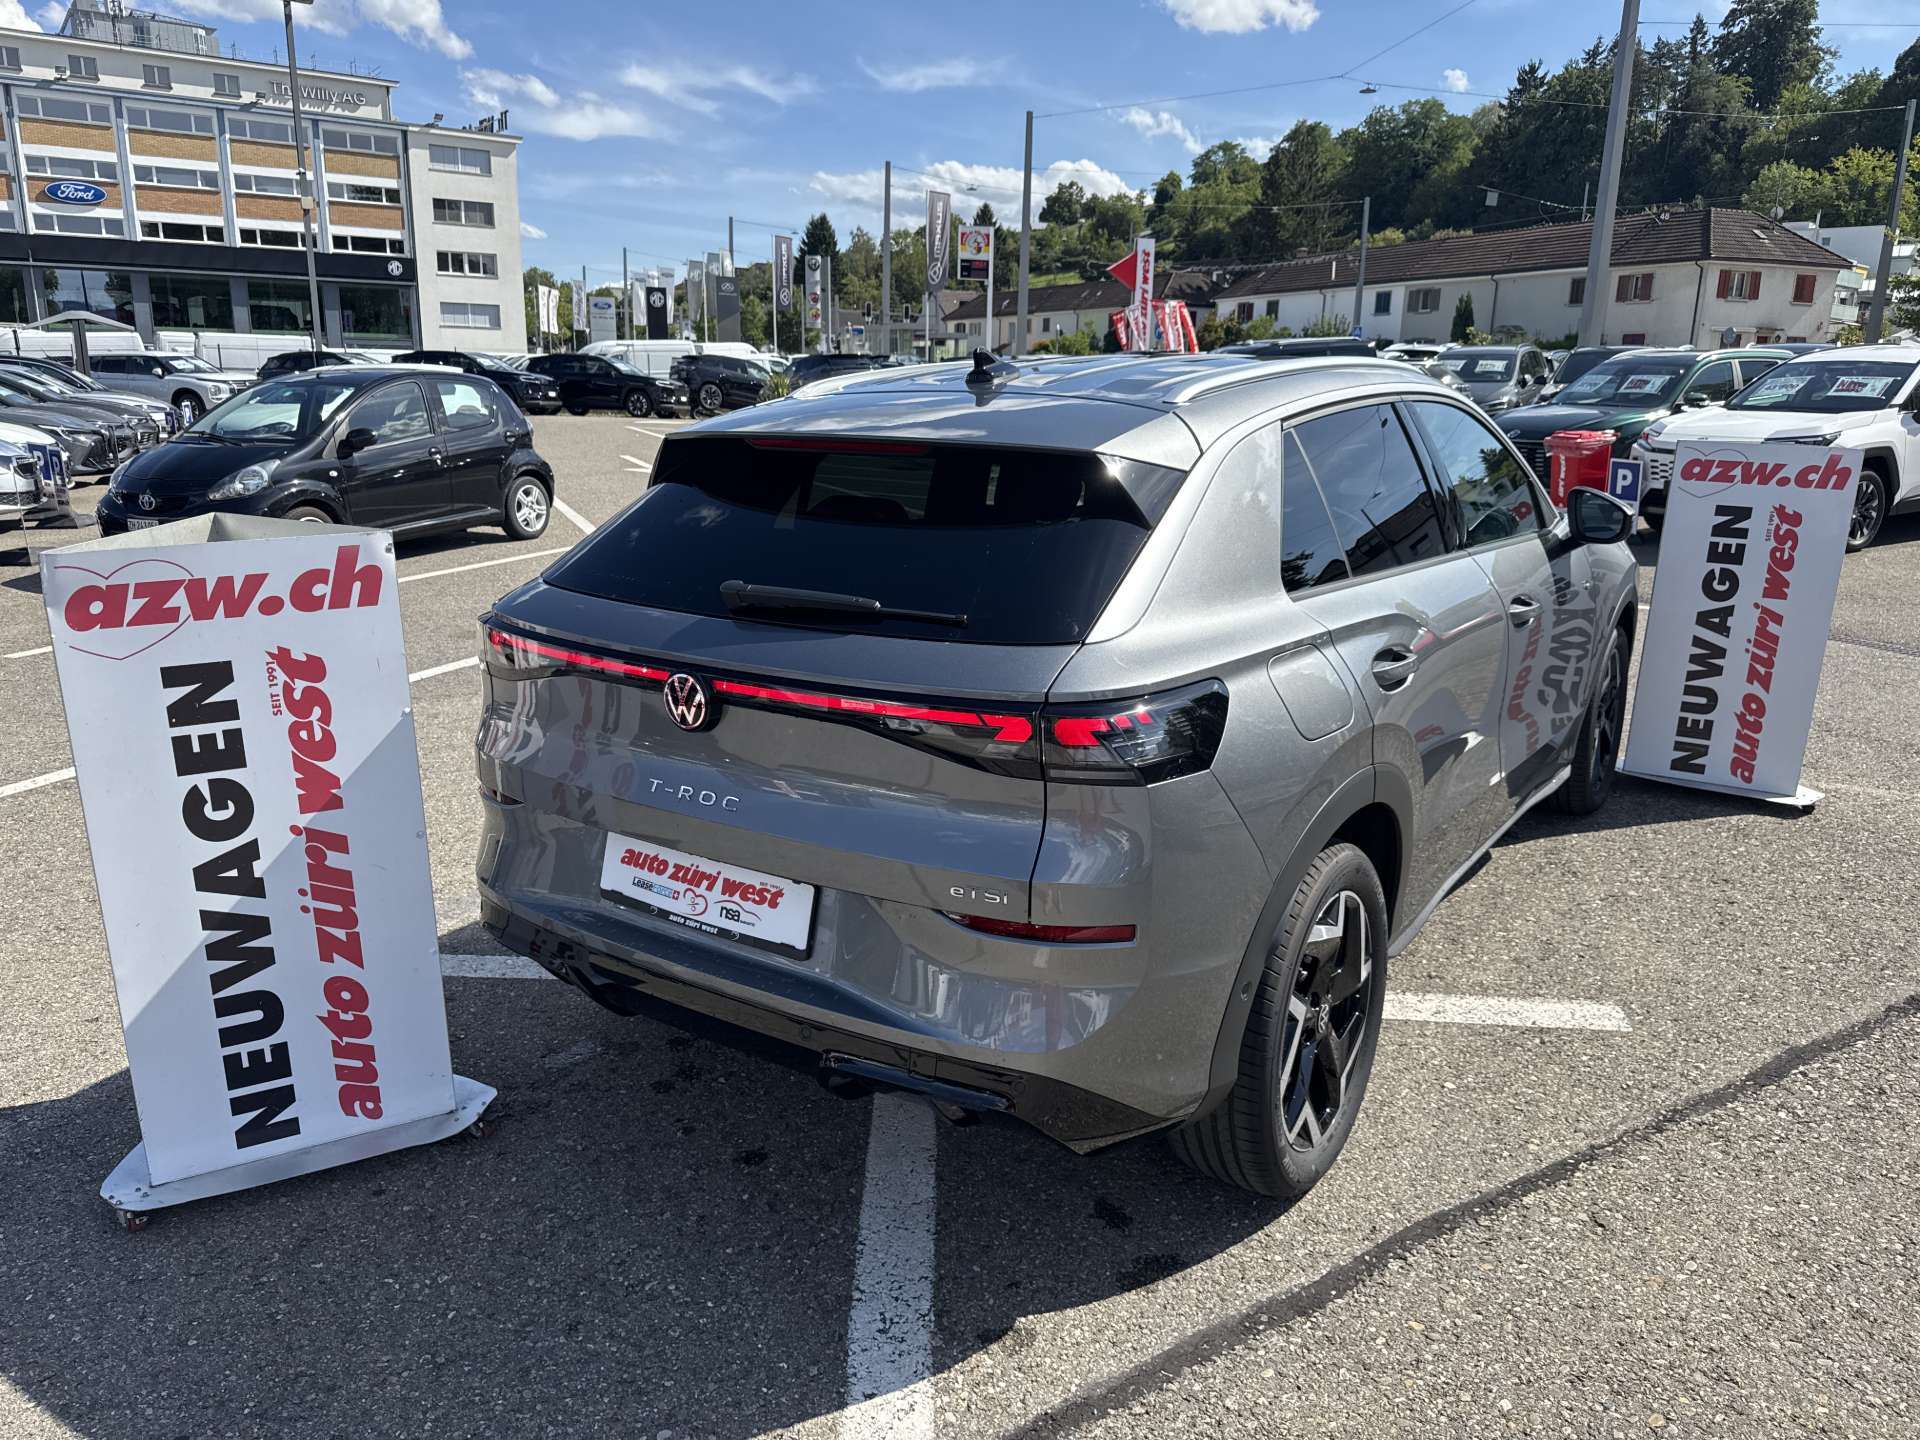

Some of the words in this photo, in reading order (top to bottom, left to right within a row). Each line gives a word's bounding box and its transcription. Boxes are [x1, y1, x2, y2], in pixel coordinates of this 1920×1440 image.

[301, 86, 339, 105] Willy
[342, 92, 366, 105] AG
[57, 183, 96, 201] Ford
[649, 290, 665, 308] MG
[1616, 468, 1633, 495] P
[1679, 454, 1852, 491] azw.ch
[1762, 503, 1803, 601] west
[64, 544, 384, 632] azw.ch
[1669, 504, 1753, 776] NEUWAGEN
[1745, 602, 1784, 695] züri
[266, 659, 277, 689] 1991
[270, 692, 283, 717] SEIT
[264, 645, 346, 815] west
[1729, 693, 1766, 784] auto
[649, 778, 740, 812] T-ROC
[288, 824, 365, 970] züri
[621, 849, 669, 875] auto
[668, 865, 721, 892] züri
[721, 878, 784, 909] west
[160, 661, 301, 1149] NEUWAGEN
[668, 914, 685, 925] auto
[701, 922, 719, 935] west
[719, 906, 740, 922] nsa
[316, 975, 384, 1120] auto
